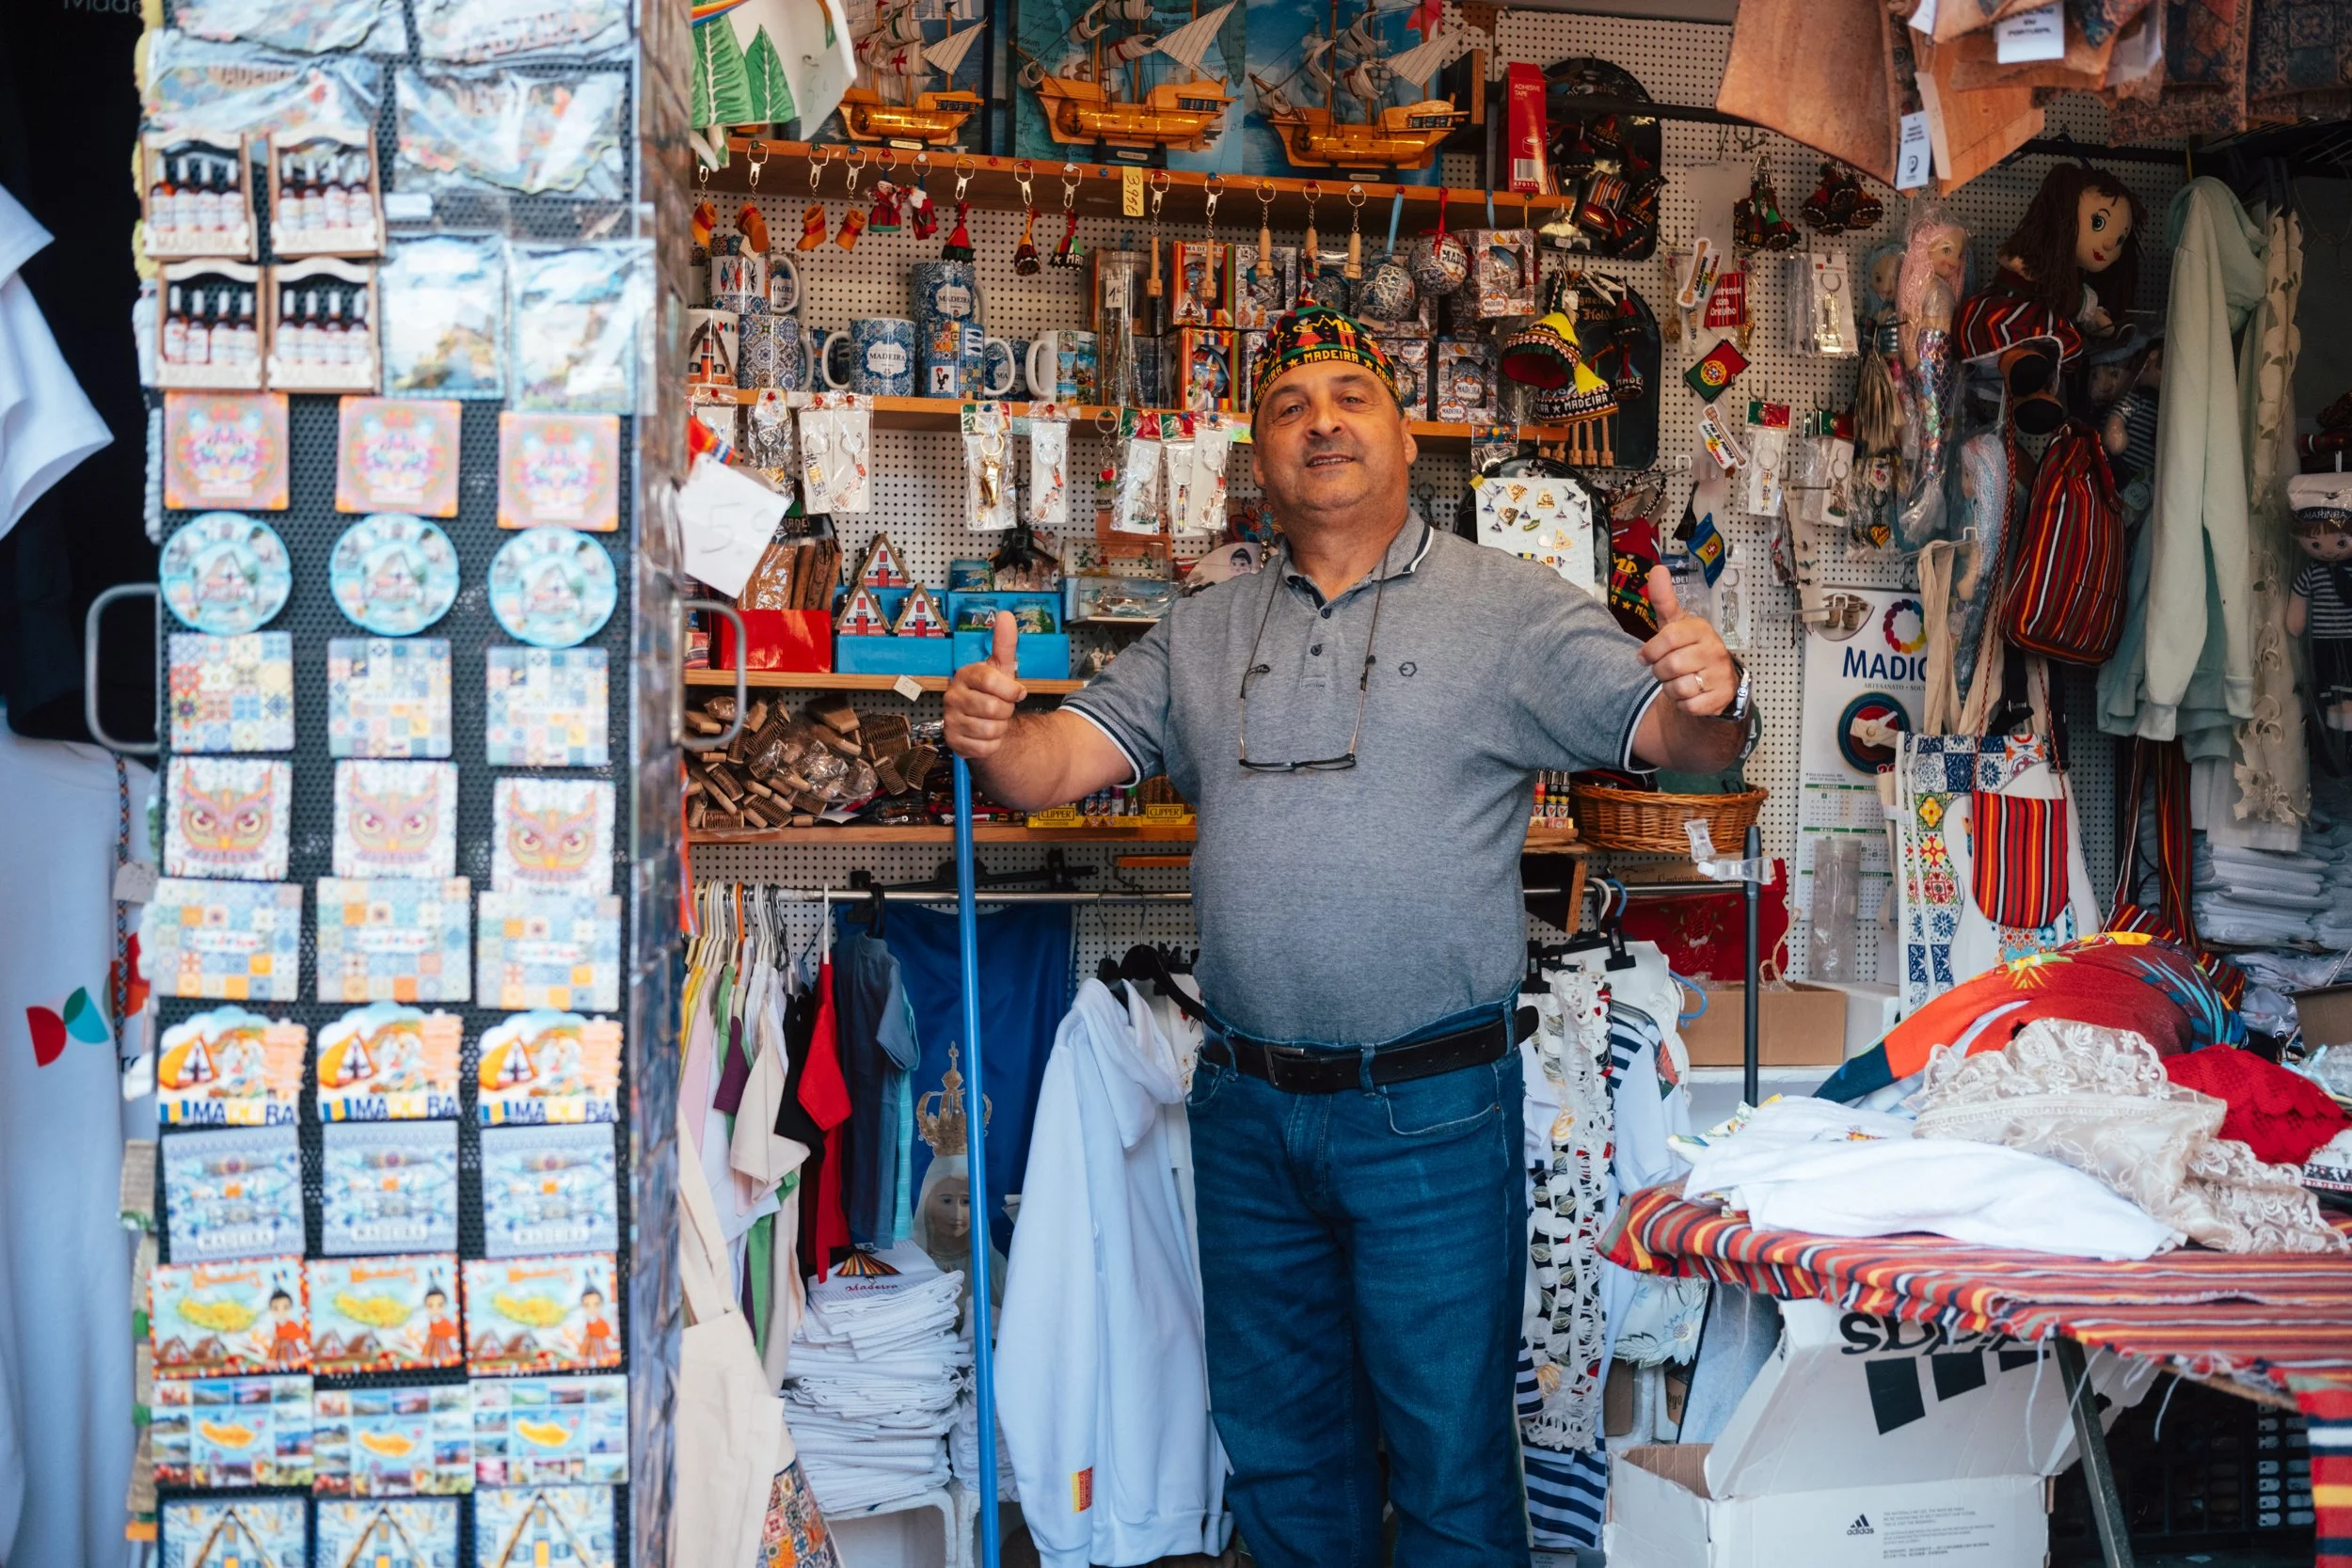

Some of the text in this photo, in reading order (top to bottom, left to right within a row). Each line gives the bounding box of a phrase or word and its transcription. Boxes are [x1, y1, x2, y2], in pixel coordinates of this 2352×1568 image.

[1514, 84, 1541, 92] ADHESIVE
[1595, 124, 1620, 143] MADE
[1184, 245, 1224, 254] MADERA
[869, 353, 906, 362] MADEIRA
[1303, 349, 1359, 364] MADEIRA
[1564, 394, 1609, 411] MADEIRA
[1041, 810, 1072, 818] CLIPPER
[1149, 808, 1180, 817] CLIPPER
[1847, 1526, 1874, 1536] adidas
